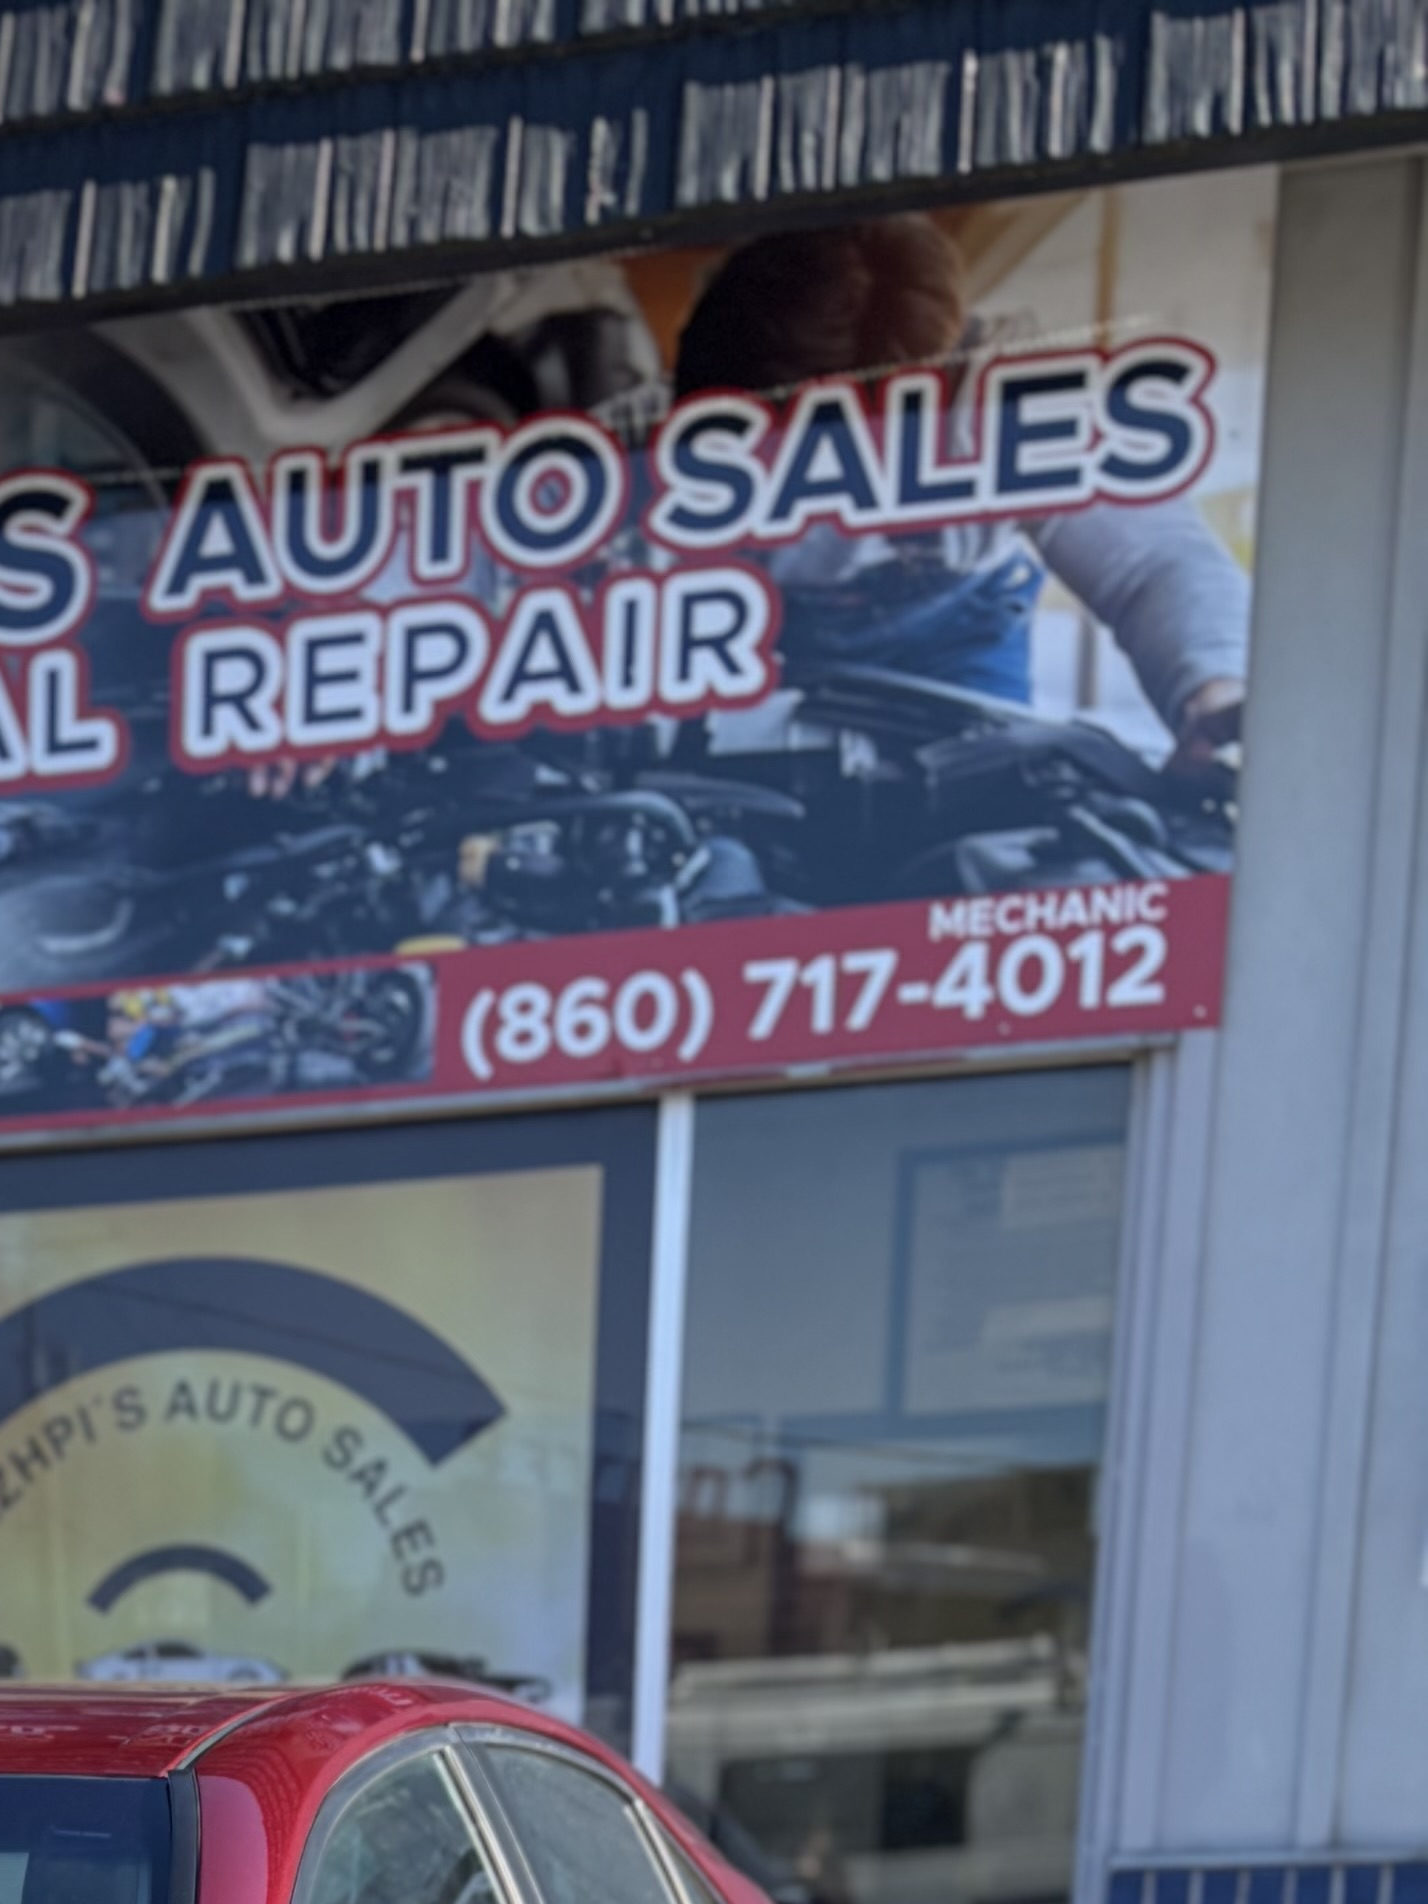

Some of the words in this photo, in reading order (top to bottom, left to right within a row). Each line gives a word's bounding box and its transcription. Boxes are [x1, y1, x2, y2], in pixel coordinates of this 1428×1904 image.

[156, 426, 606, 605] AUTO
[654, 350, 1202, 542] SALES
[189, 575, 759, 750] REPAIR
[928, 882, 1167, 941] MECHANIC
[460, 966, 714, 1081] (860)
[744, 924, 1167, 1040] 717-4012
[164, 1378, 315, 1444] AUTO
[322, 1427, 445, 1599] SALES
